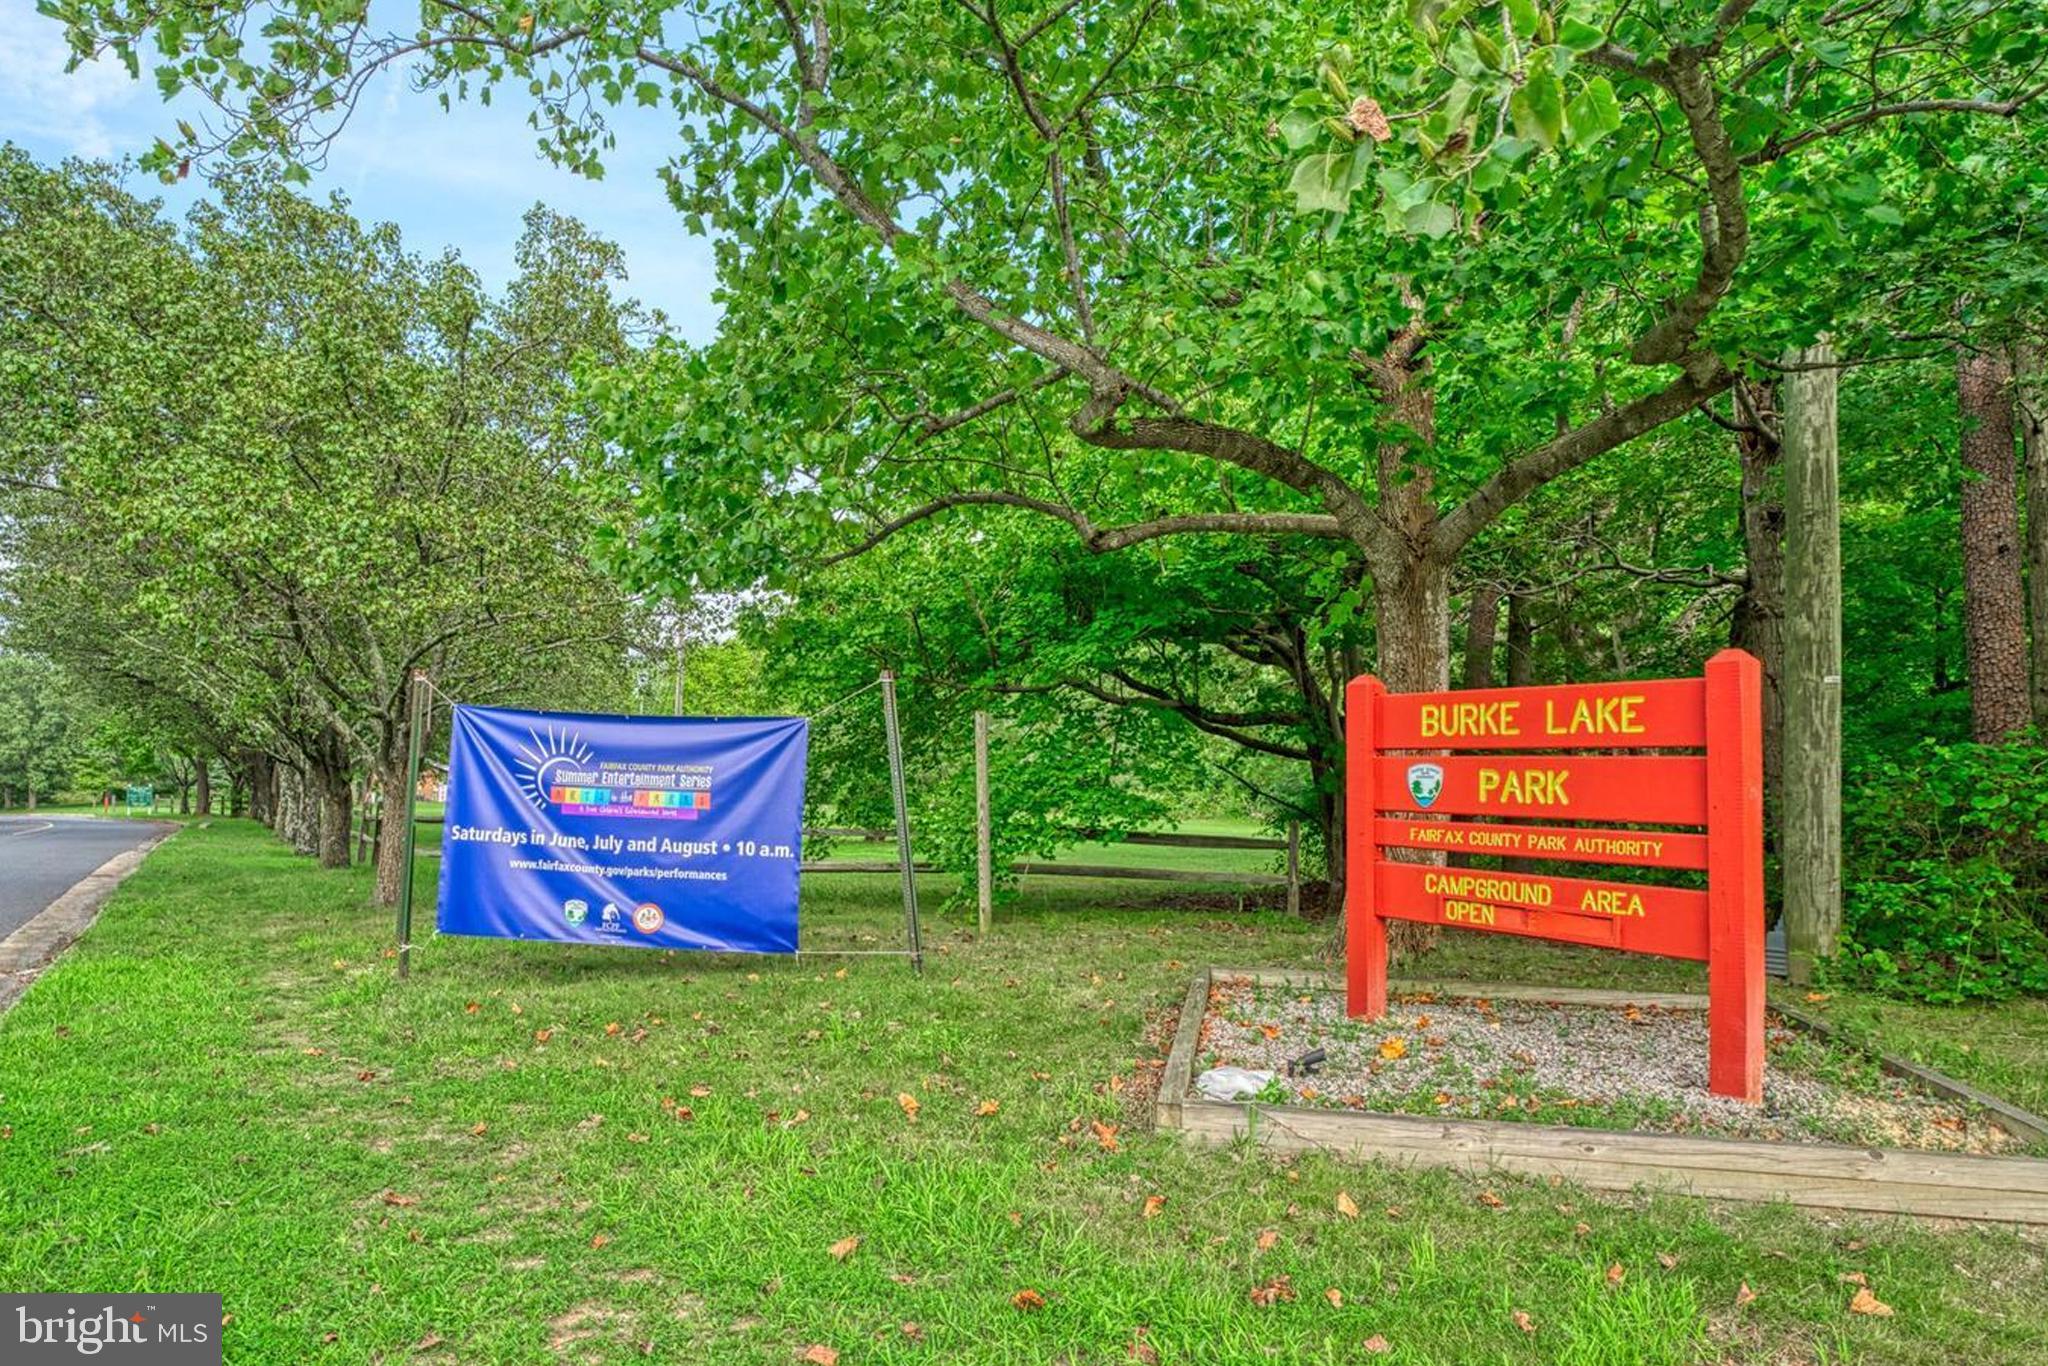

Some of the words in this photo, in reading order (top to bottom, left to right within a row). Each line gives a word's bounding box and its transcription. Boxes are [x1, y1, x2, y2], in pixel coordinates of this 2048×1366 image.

[1421, 701, 1520, 737] BURKE
[1546, 696, 1645, 735] LAKE
[555, 769, 599, 784] Summer
[601, 772, 676, 788] Entertainment
[680, 774, 712, 789] Series
[600, 761, 627, 771] FAIRFAX
[628, 762, 656, 772] COUNTY
[657, 764, 676, 773] PARK
[676, 764, 714, 774] AUTHORITY
[1478, 768, 1569, 805] PARK
[451, 825, 527, 847] Saturdays
[531, 829, 546, 845] in
[550, 832, 589, 851] June,
[593, 835, 623, 855] July
[627, 837, 657, 853] and
[660, 838, 718, 858] August
[736, 841, 756, 857] 10
[759, 844, 795, 858] a.m.
[1410, 827, 1464, 844] FAIRFAX
[1469, 830, 1521, 848] COUNTY
[1528, 834, 1566, 850] PARK
[1574, 837, 1663, 857] AUTHORITY
[509, 858, 728, 881] www.fairfaxcounty.gov/parks/performances
[1424, 873, 1552, 906] CAMPGROUND
[1581, 888, 1645, 917] AREA
[1446, 900, 1495, 924] OPEN
